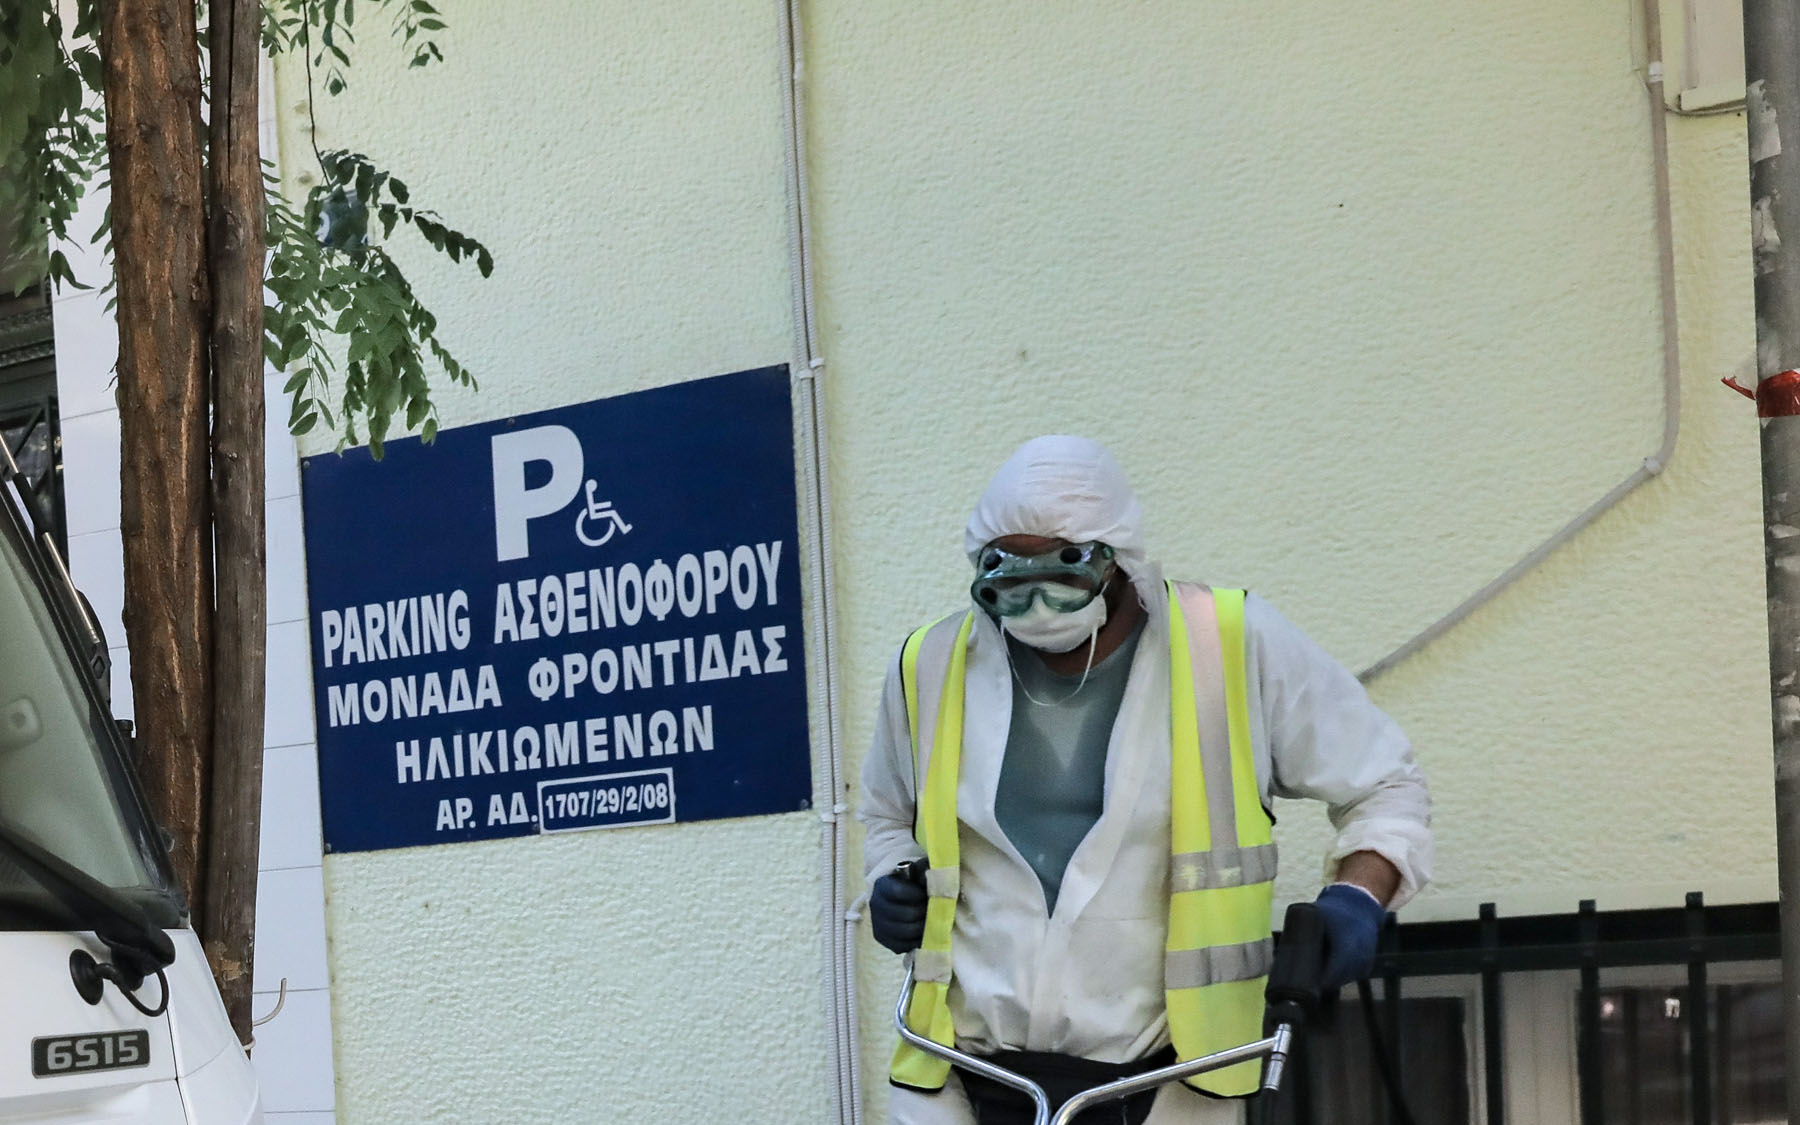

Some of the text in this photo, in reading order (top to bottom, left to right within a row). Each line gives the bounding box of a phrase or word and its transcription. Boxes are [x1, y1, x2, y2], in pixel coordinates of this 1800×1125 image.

[491, 424, 585, 562] P
[321, 540, 783, 668] PARKING ΑΣΘΕΝΟΦΟΡΟΥ
[327, 625, 788, 728] ΜΟΝΑΔΑ ΦΡΟΝΤΙΔΑΣ
[396, 705, 714, 784] ΗΛΙΚΙΩΜΕΝΩΝ
[436, 783, 669, 831] ΑΡ. ΑΔ. 1707/29/2/08
